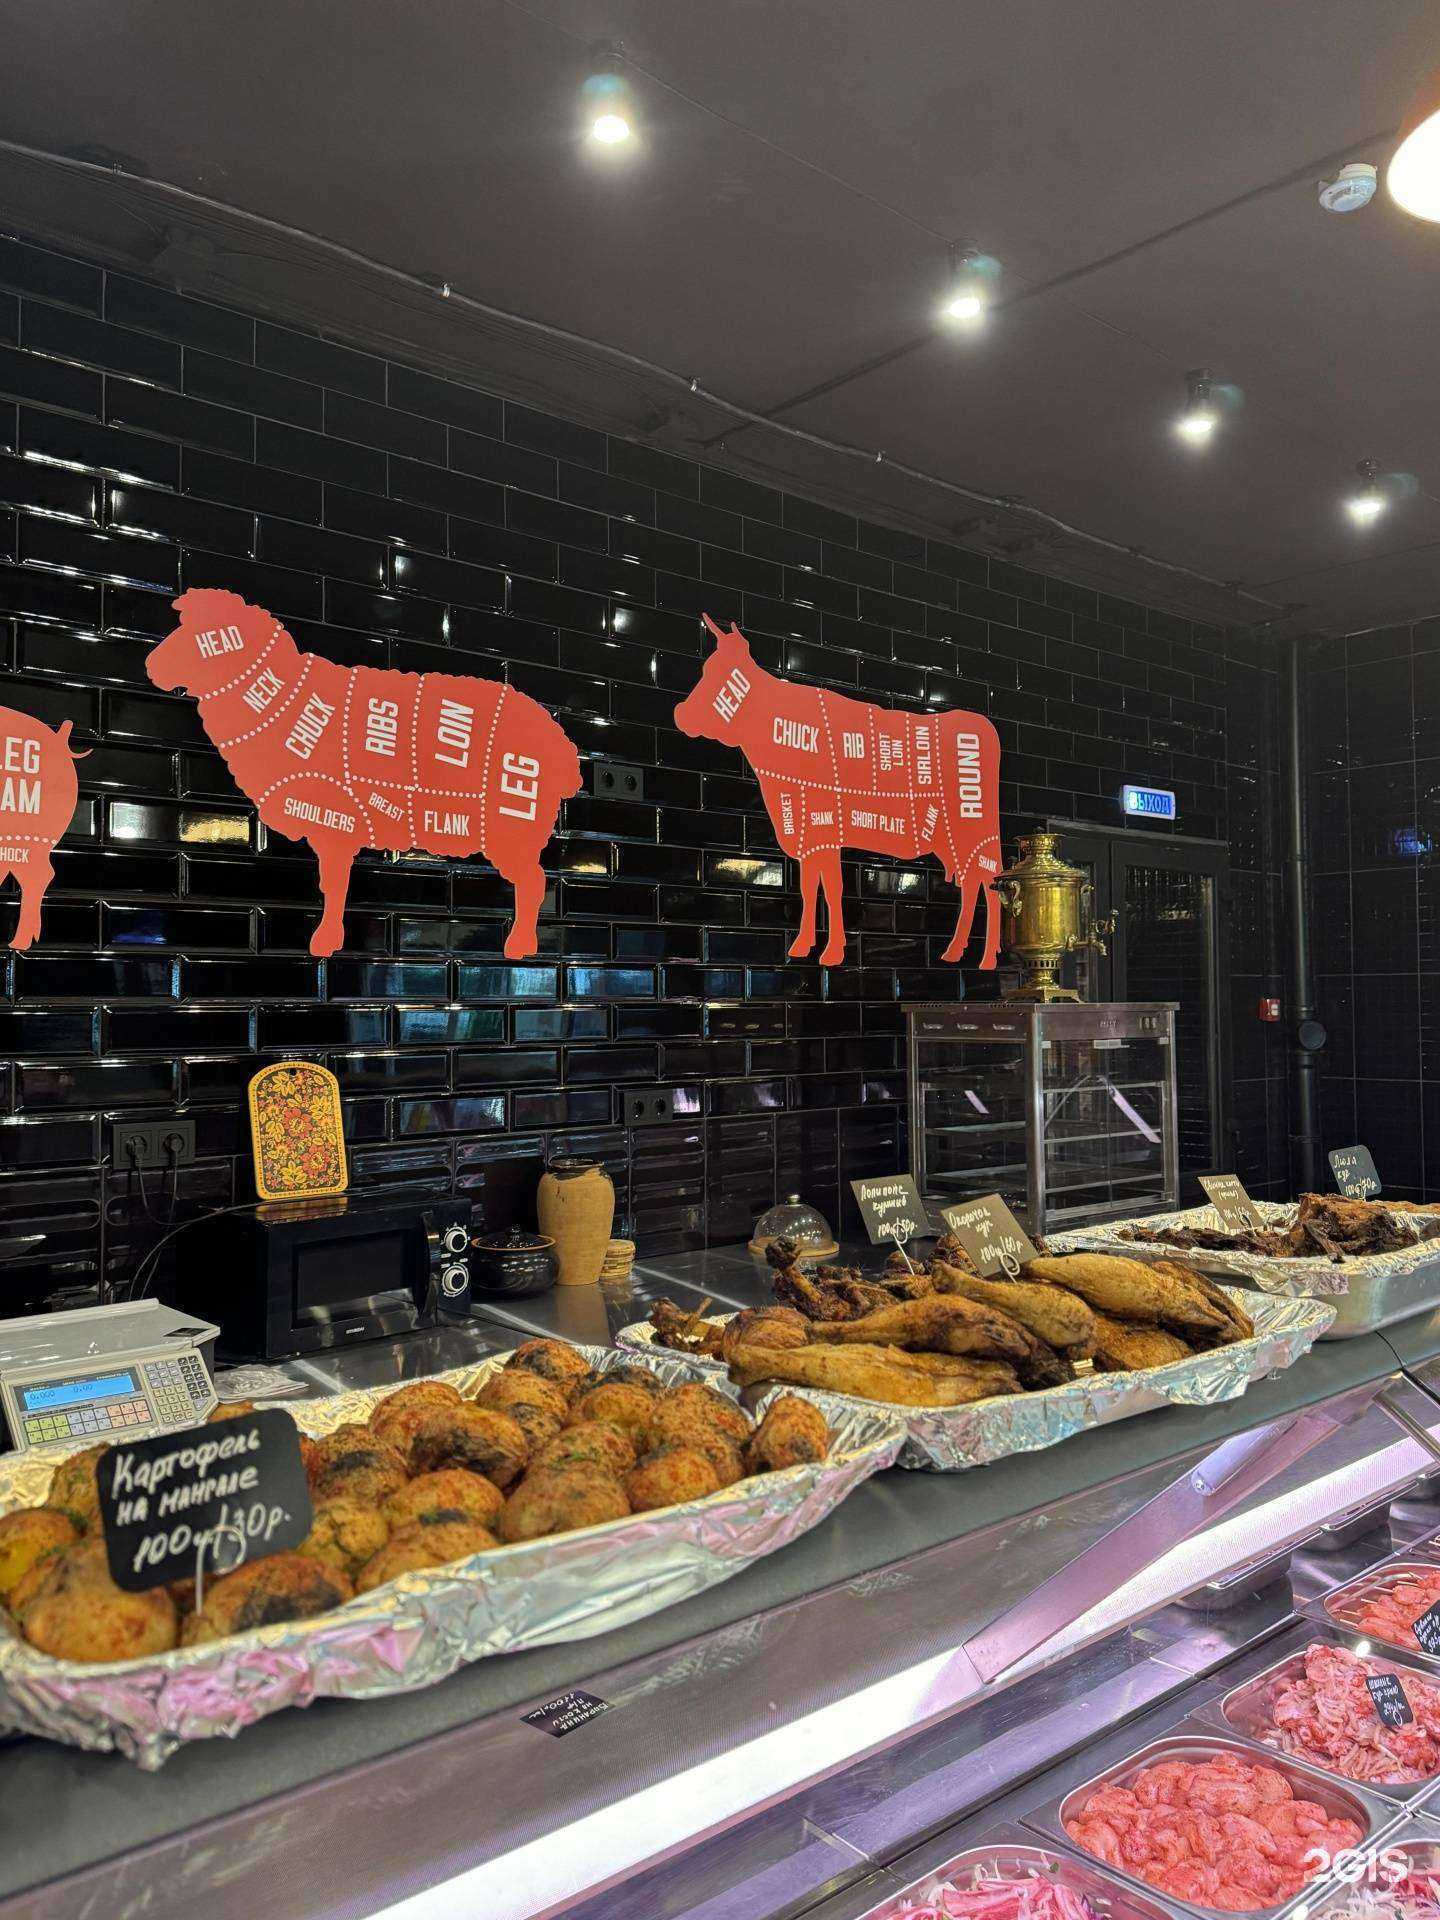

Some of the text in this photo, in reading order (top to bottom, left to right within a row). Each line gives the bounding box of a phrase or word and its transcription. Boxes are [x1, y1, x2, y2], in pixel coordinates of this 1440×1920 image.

[195, 625, 243, 659] HEAD
[243, 668, 284, 714] NECK
[711, 667, 751, 723] HEAD
[284, 692, 336, 761] CHUCK
[364, 696, 399, 757] RIBS
[434, 698, 475, 769] LOIN
[773, 716, 820, 754] CHUCK
[843, 732, 865, 759] RIB
[0, 736, 41, 775] EG
[879, 732, 893, 772] SHORT
[892, 739, 904, 767] LOIN
[915, 725, 932, 785] SIRLOIN
[499, 752, 541, 822] LEG
[957, 732, 984, 819] ROUND
[0, 776, 41, 815] AM
[283, 796, 356, 834] SHOULDERS
[368, 791, 405, 823] BREAST
[780, 792, 795, 836] BRISKET
[1129, 791, 1171, 813] ВЫХОД
[424, 810, 471, 837] FLANK
[810, 811, 834, 826] SHANK
[851, 809, 906, 835] SHORT PLATE
[921, 806, 940, 842] FLANK
[978, 854, 998, 874] SHANK
[111, 1429, 261, 1500] Картофель
